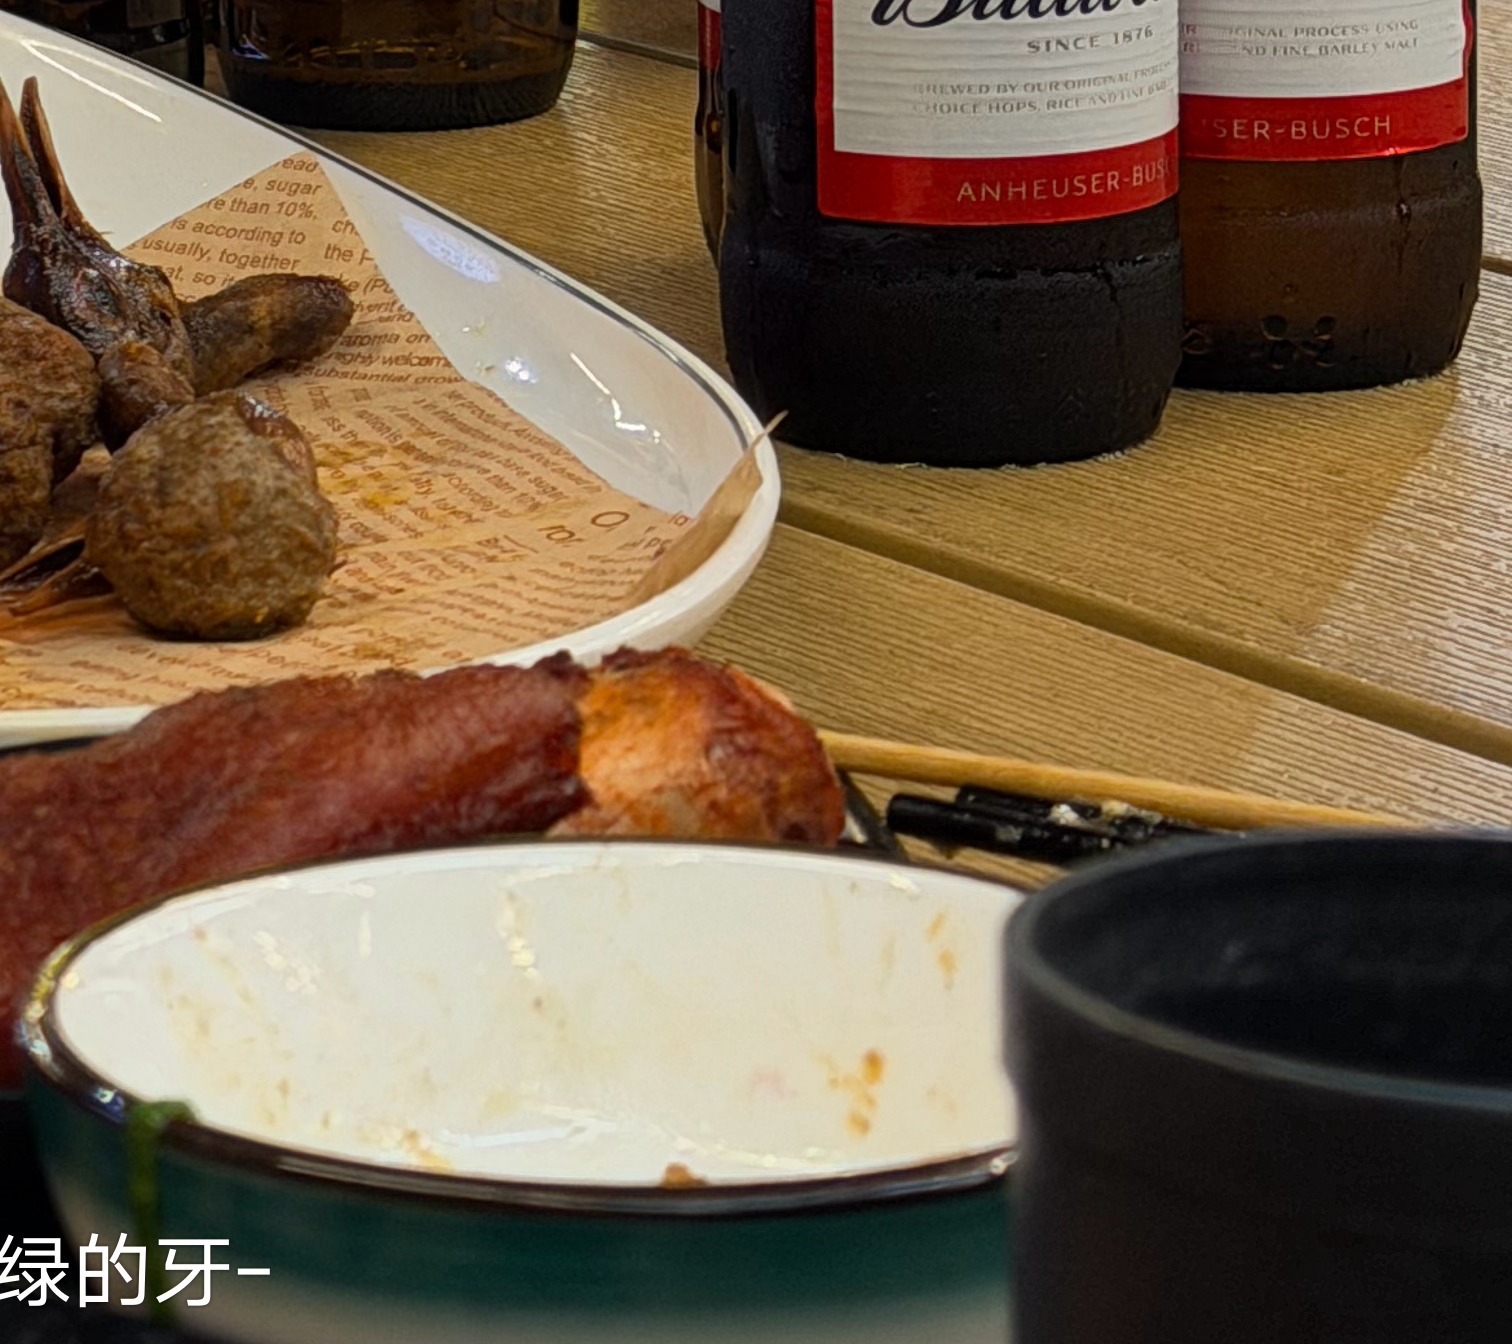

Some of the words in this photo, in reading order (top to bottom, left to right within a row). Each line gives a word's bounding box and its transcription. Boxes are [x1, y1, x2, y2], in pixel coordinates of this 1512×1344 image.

[1027, 35, 1100, 54] SINCE
[1113, 25, 1154, 46] 1876
[997, 82, 1019, 94] BY
[1023, 81, 1060, 93] OUR
[1213, 115, 1391, 141] SER-BUSCH
[265, 177, 322, 196] sugar
[229, 197, 270, 216] than
[191, 220, 285, 247] according
[287, 227, 307, 245] to
[142, 235, 212, 262] usually,
[218, 246, 301, 272] together
[324, 243, 354, 262] the
[192, 269, 217, 287] so
